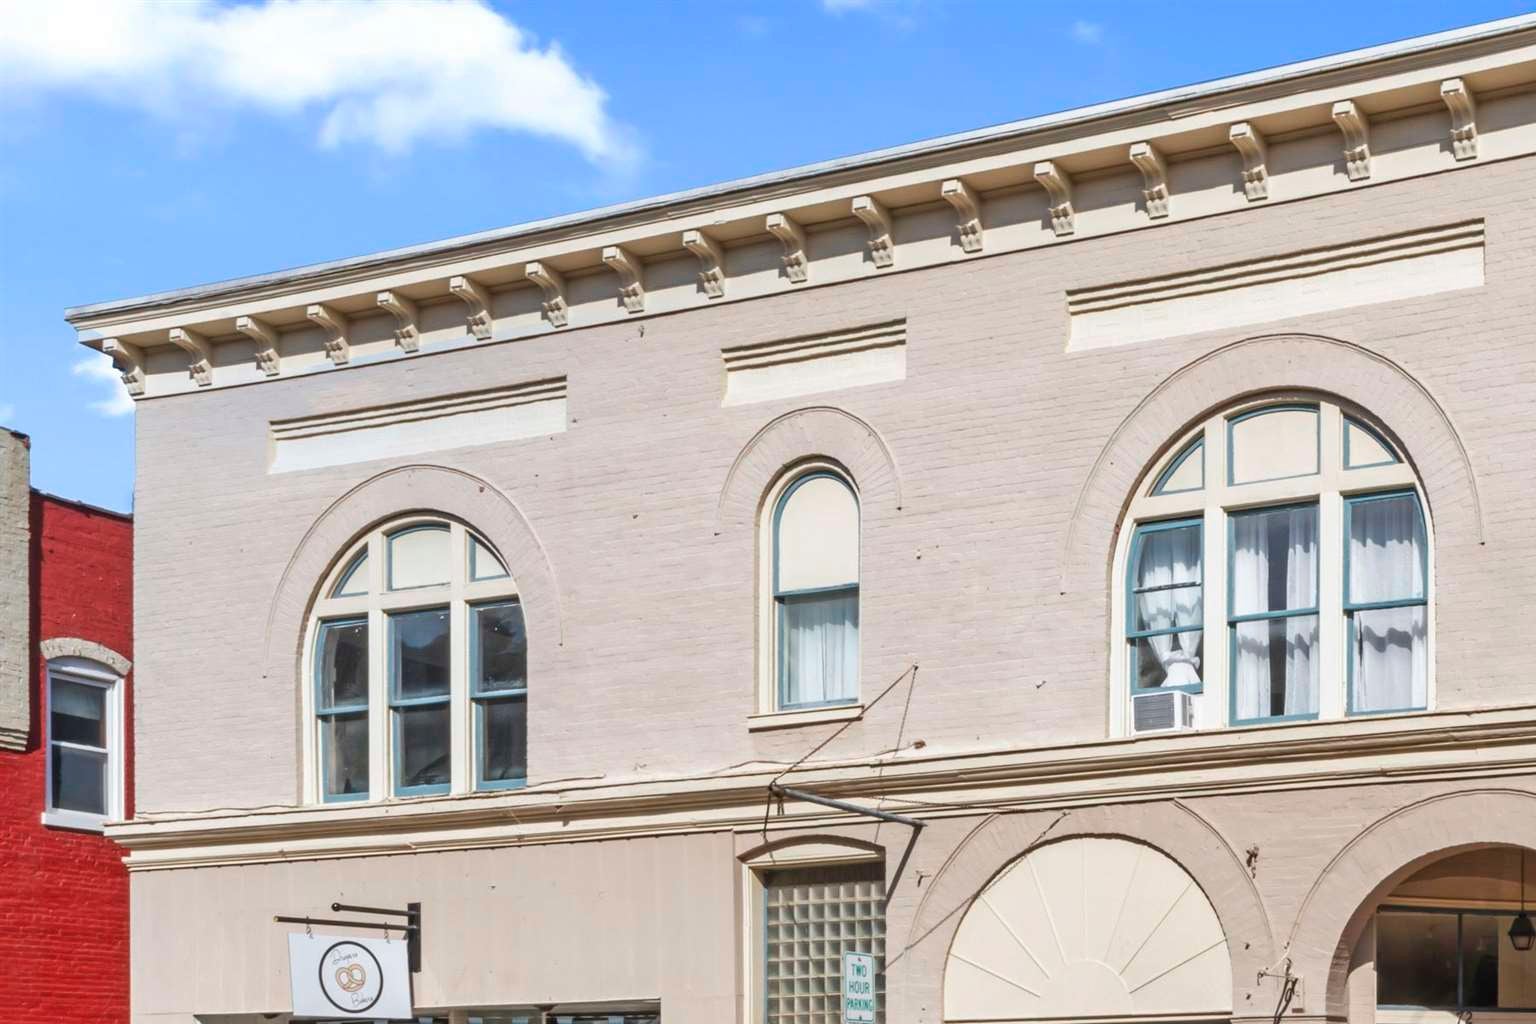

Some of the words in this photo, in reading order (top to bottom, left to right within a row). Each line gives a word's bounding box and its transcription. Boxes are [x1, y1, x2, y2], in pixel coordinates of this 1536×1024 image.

[851, 963, 867, 978] TWO
[849, 981, 870, 994] HOUR
[847, 998, 873, 1011] PARKING
